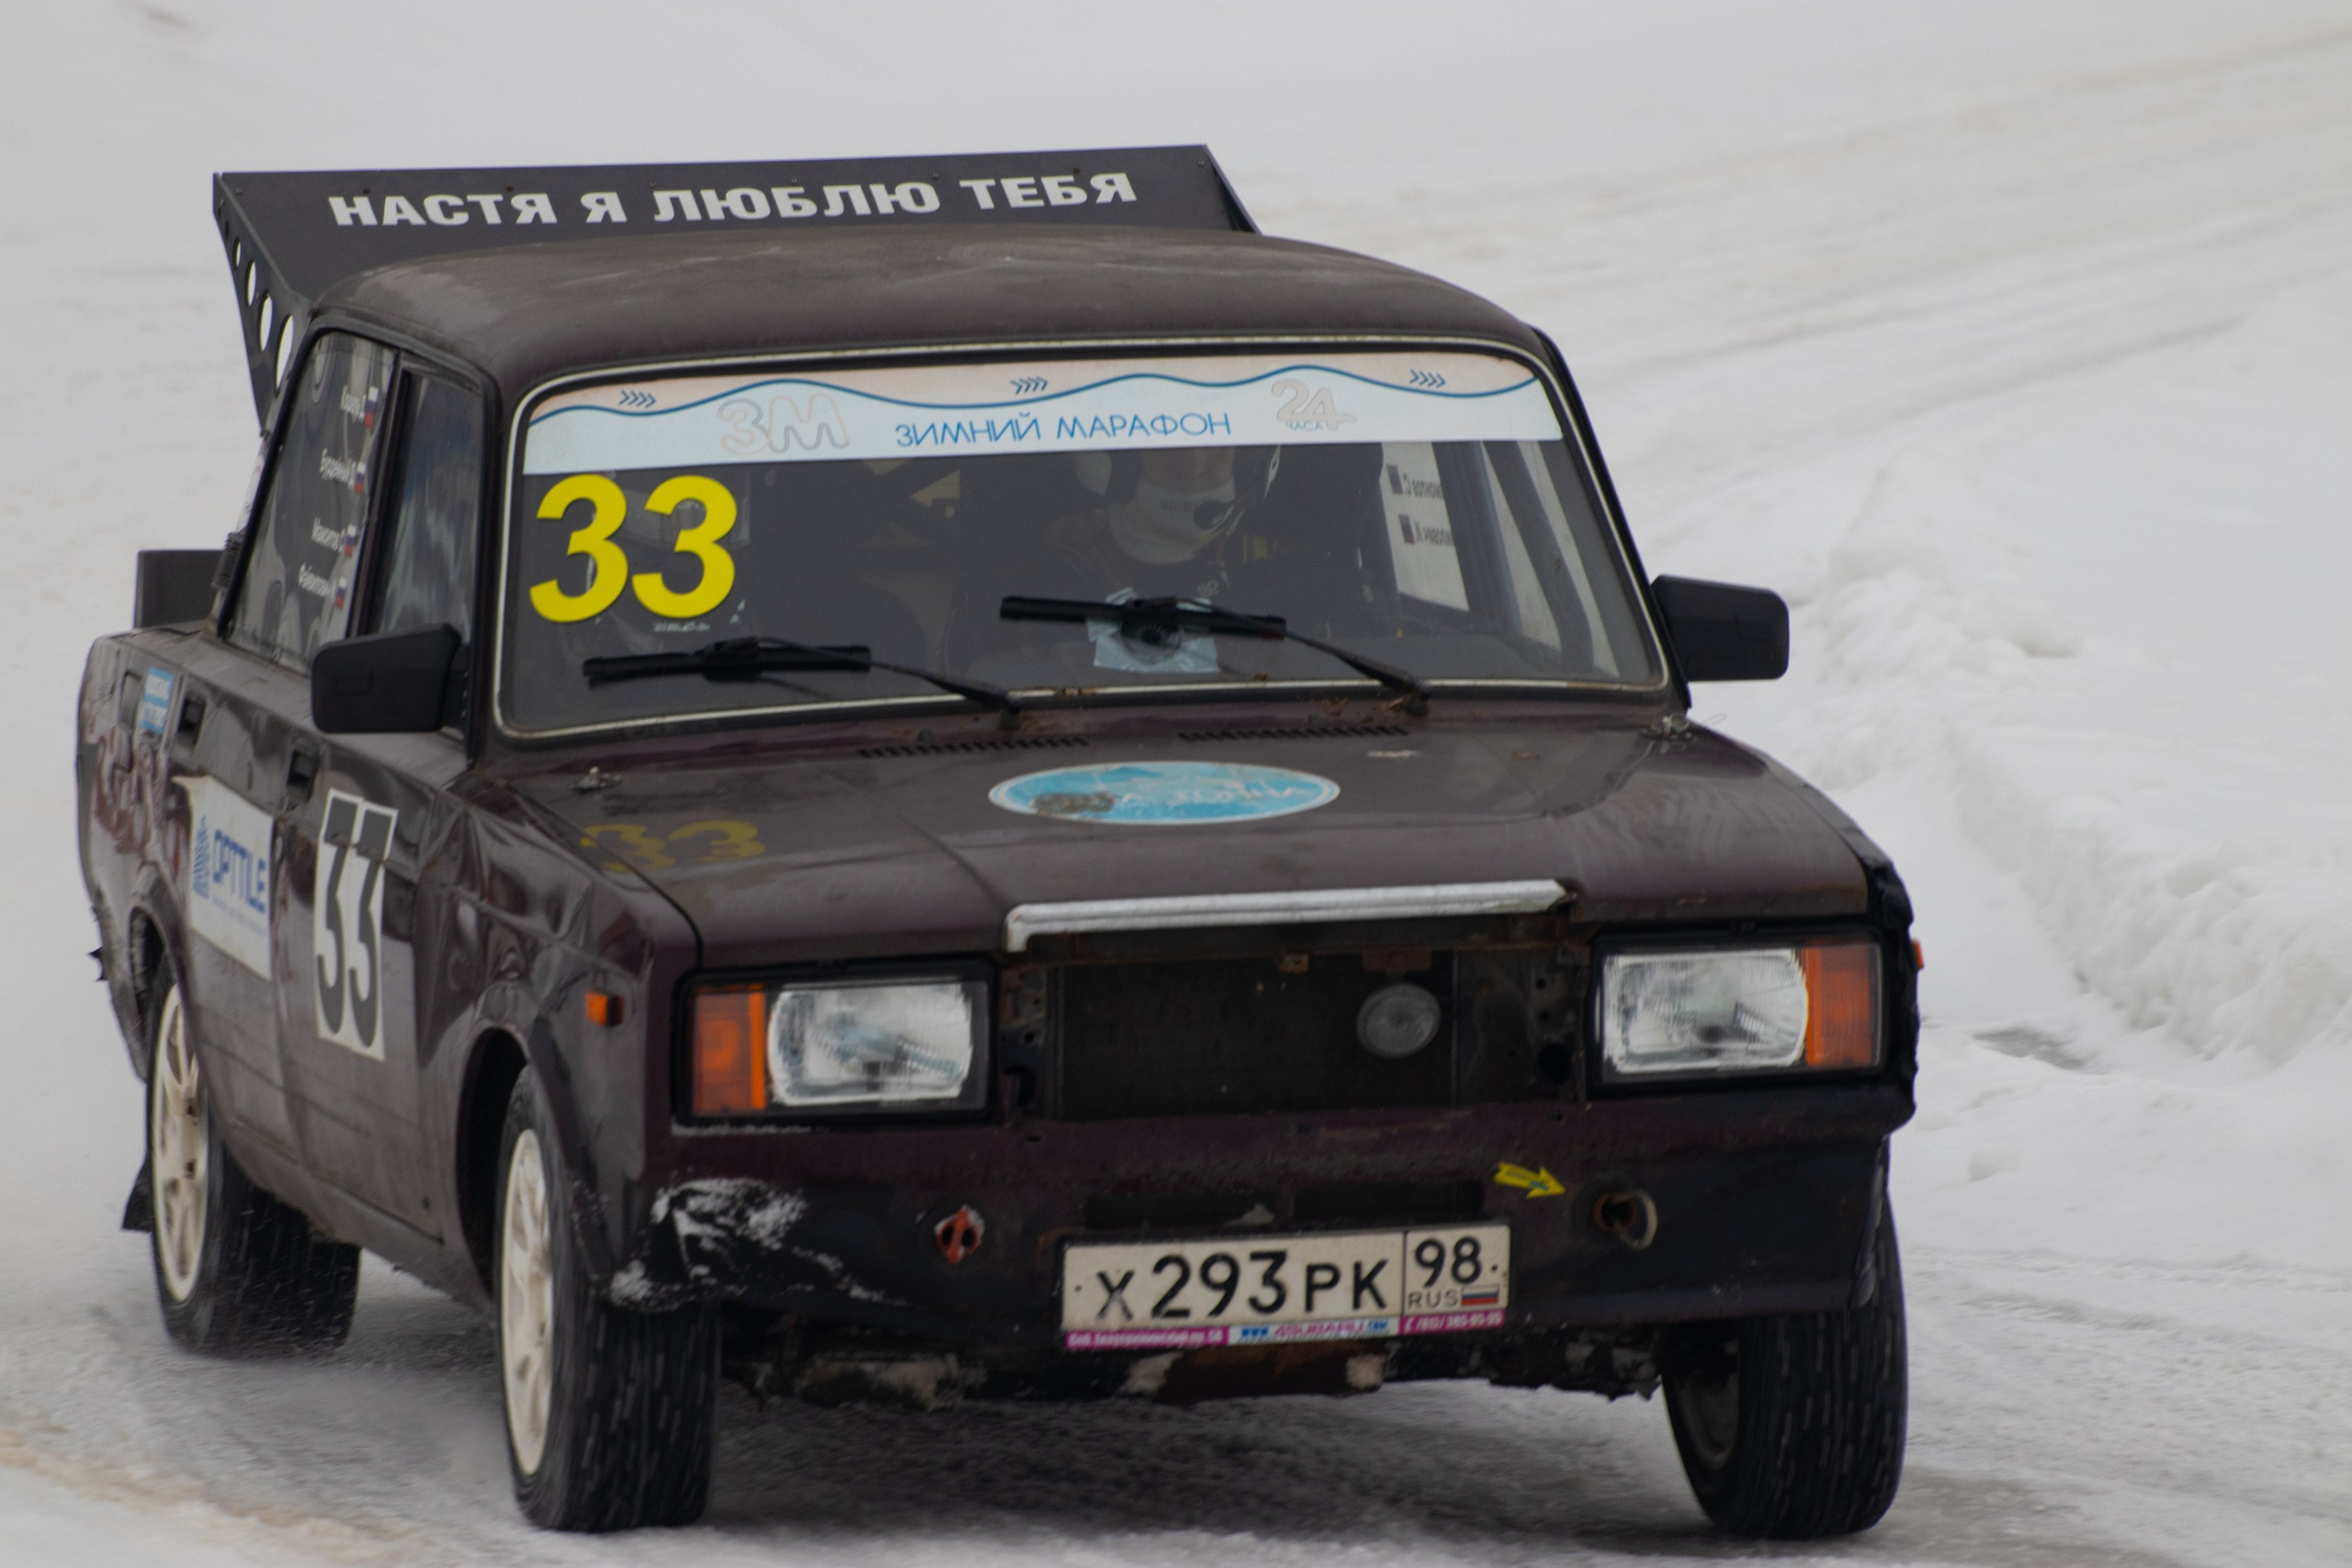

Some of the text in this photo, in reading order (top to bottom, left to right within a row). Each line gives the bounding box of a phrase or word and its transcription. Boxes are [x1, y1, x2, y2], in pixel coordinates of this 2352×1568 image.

[328, 172, 1137, 226] НАСТЯ Я ЛЮБЛЮ ТЕБЯ
[895, 412, 1230, 448] ЗИМНИЙ МАРАФОН
[1271, 379, 1358, 432] 24
[529, 473, 738, 623] 33
[317, 797, 394, 1048] 33
[1414, 1236, 1481, 1288] 98
[1408, 1288, 1458, 1308] RUS
